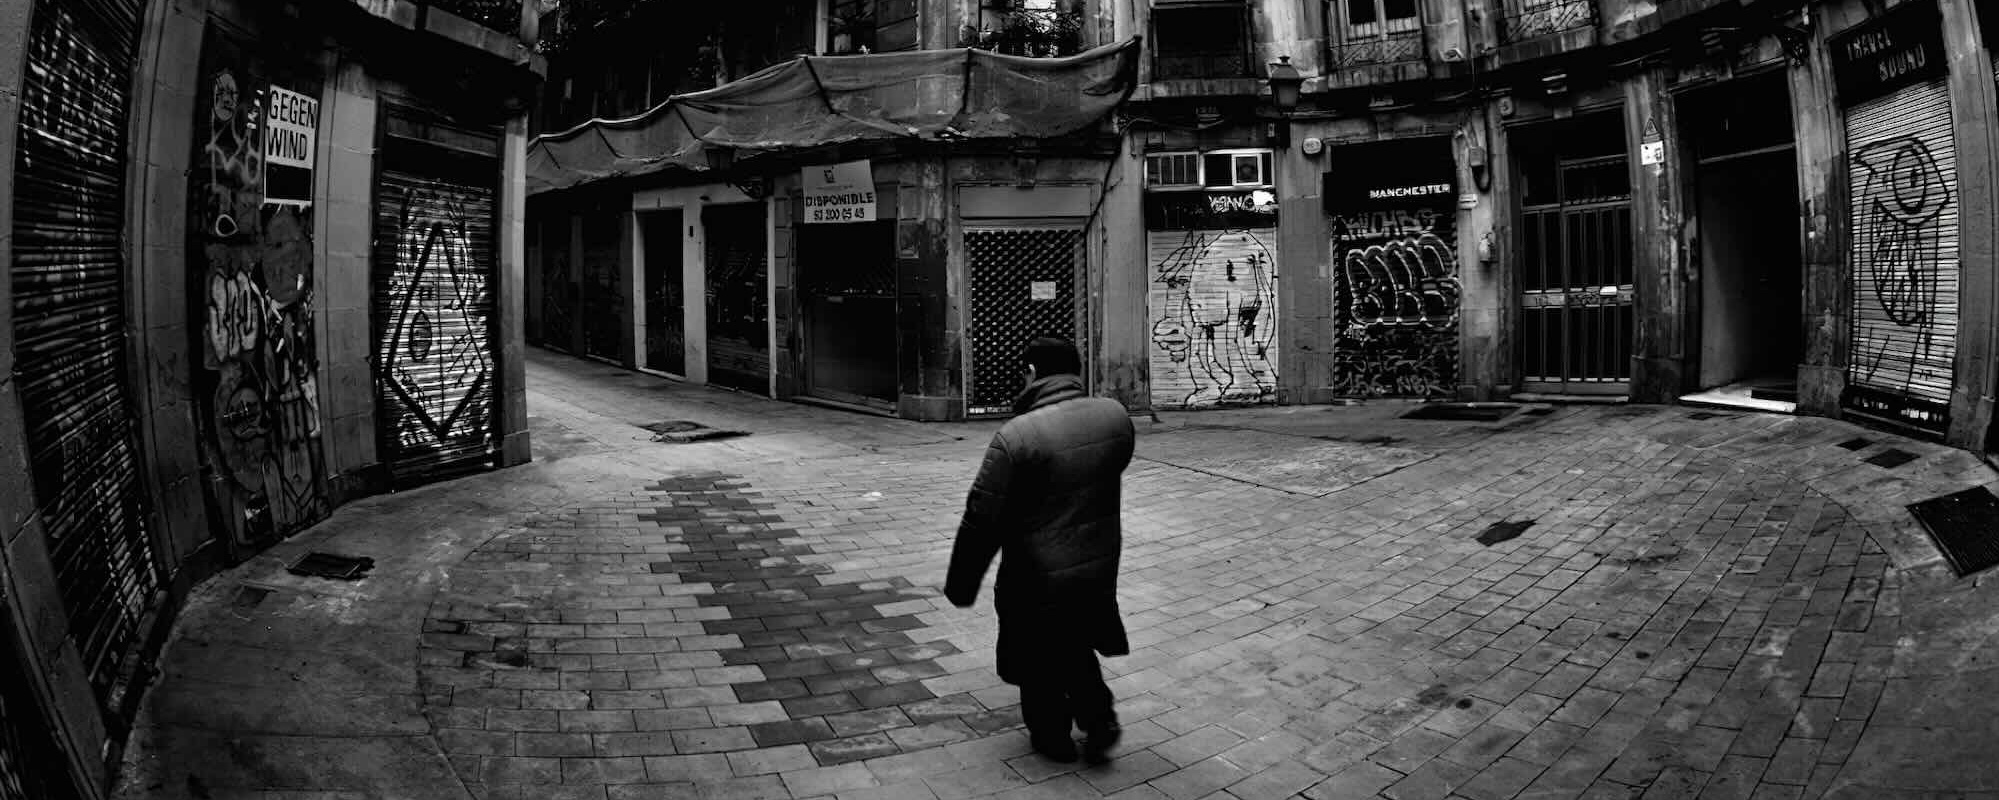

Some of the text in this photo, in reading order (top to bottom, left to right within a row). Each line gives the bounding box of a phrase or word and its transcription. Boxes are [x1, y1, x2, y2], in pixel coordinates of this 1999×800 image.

[1879, 43, 1925, 82] SOUND
[269, 89, 317, 129] GEGEN
[265, 125, 308, 161] WIND
[805, 192, 874, 207] DISPONIBLE
[1369, 183, 1450, 199] MANCHESTER
